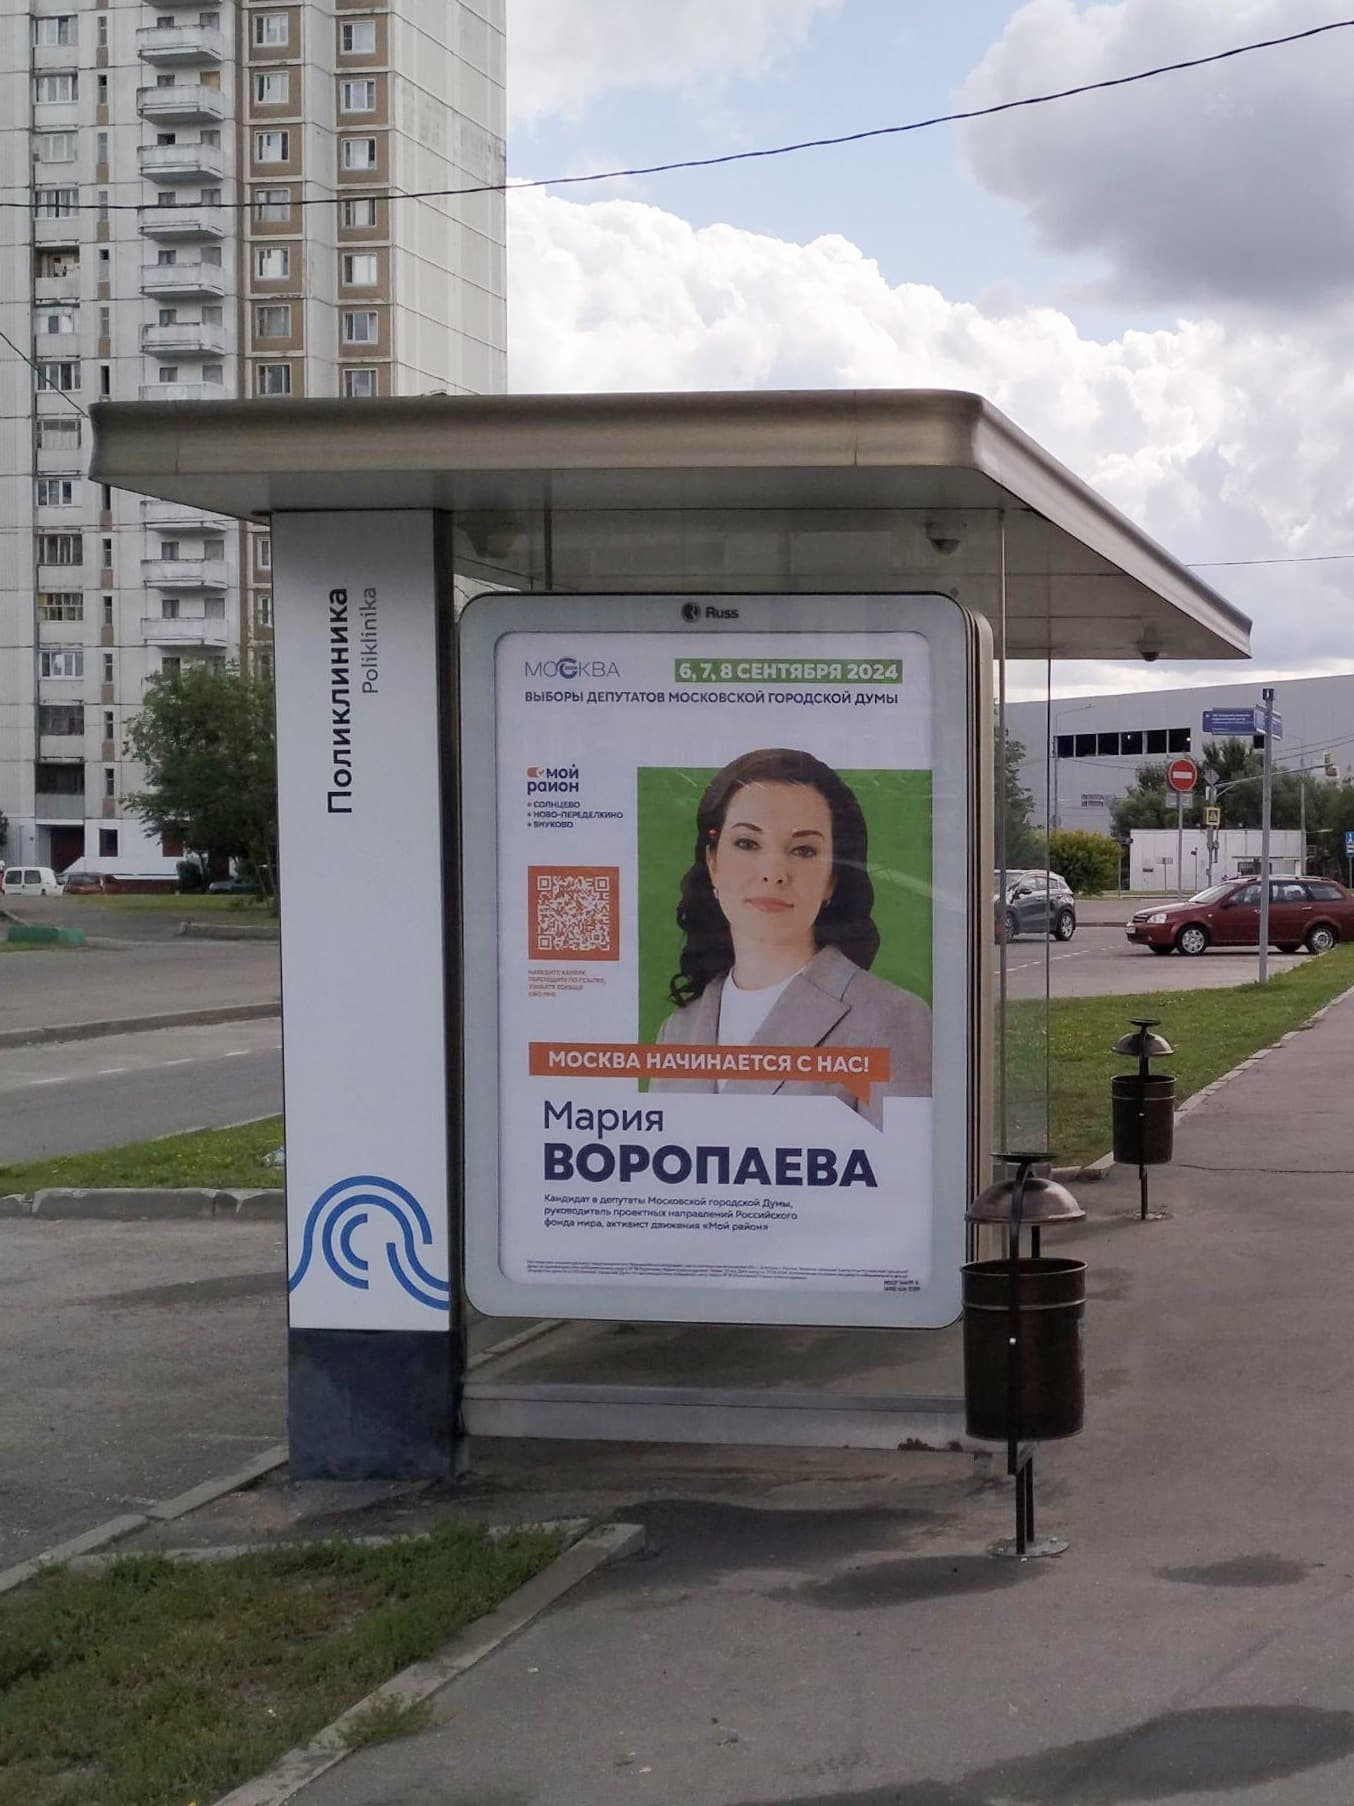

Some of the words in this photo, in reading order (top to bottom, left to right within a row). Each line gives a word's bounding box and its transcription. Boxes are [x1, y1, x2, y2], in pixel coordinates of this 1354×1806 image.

[705, 606, 739, 619] Russ
[360, 587, 378, 693] Poliklinika
[679, 663, 697, 681] 6,
[700, 663, 716, 681] 7,
[720, 663, 732, 679] 8
[737, 663, 842, 679] СЕНТЯБРЯ
[847, 664, 898, 680] 2024
[328, 588, 352, 813] Поликлиника
[525, 691, 584, 702] ВЫБОРЫ
[587, 692, 665, 704] ДЕПУТАТОВ
[668, 690, 765, 703] МОСКОВСКОЙ
[768, 690, 851, 705] ГОРОДСКОЙ
[854, 693, 898, 705] ДУМЫ
[546, 764, 579, 779] мой
[533, 801, 580, 809] СОЛНЦЕВО
[548, 1050, 641, 1069] МОСКВА
[646, 1052, 792, 1072] НАЧИНАЕТСЯ
[797, 1055, 811, 1072] С
[816, 1055, 870, 1073] НАС!
[543, 1100, 664, 1138] Мария
[543, 1142, 879, 1188] ВОРОПАЕВА
[544, 1194, 590, 1204] Кандидат
[600, 1197, 645, 1206] депутаты
[647, 1196, 706, 1206] Московской
[544, 1207, 611, 1216] руководитель
[613, 1208, 665, 1217] проектных
[668, 1209, 733, 1219] направлений
[735, 1210, 798, 1220] Российского
[544, 1218, 575, 1228] фонда
[606, 1221, 649, 1229] активист
